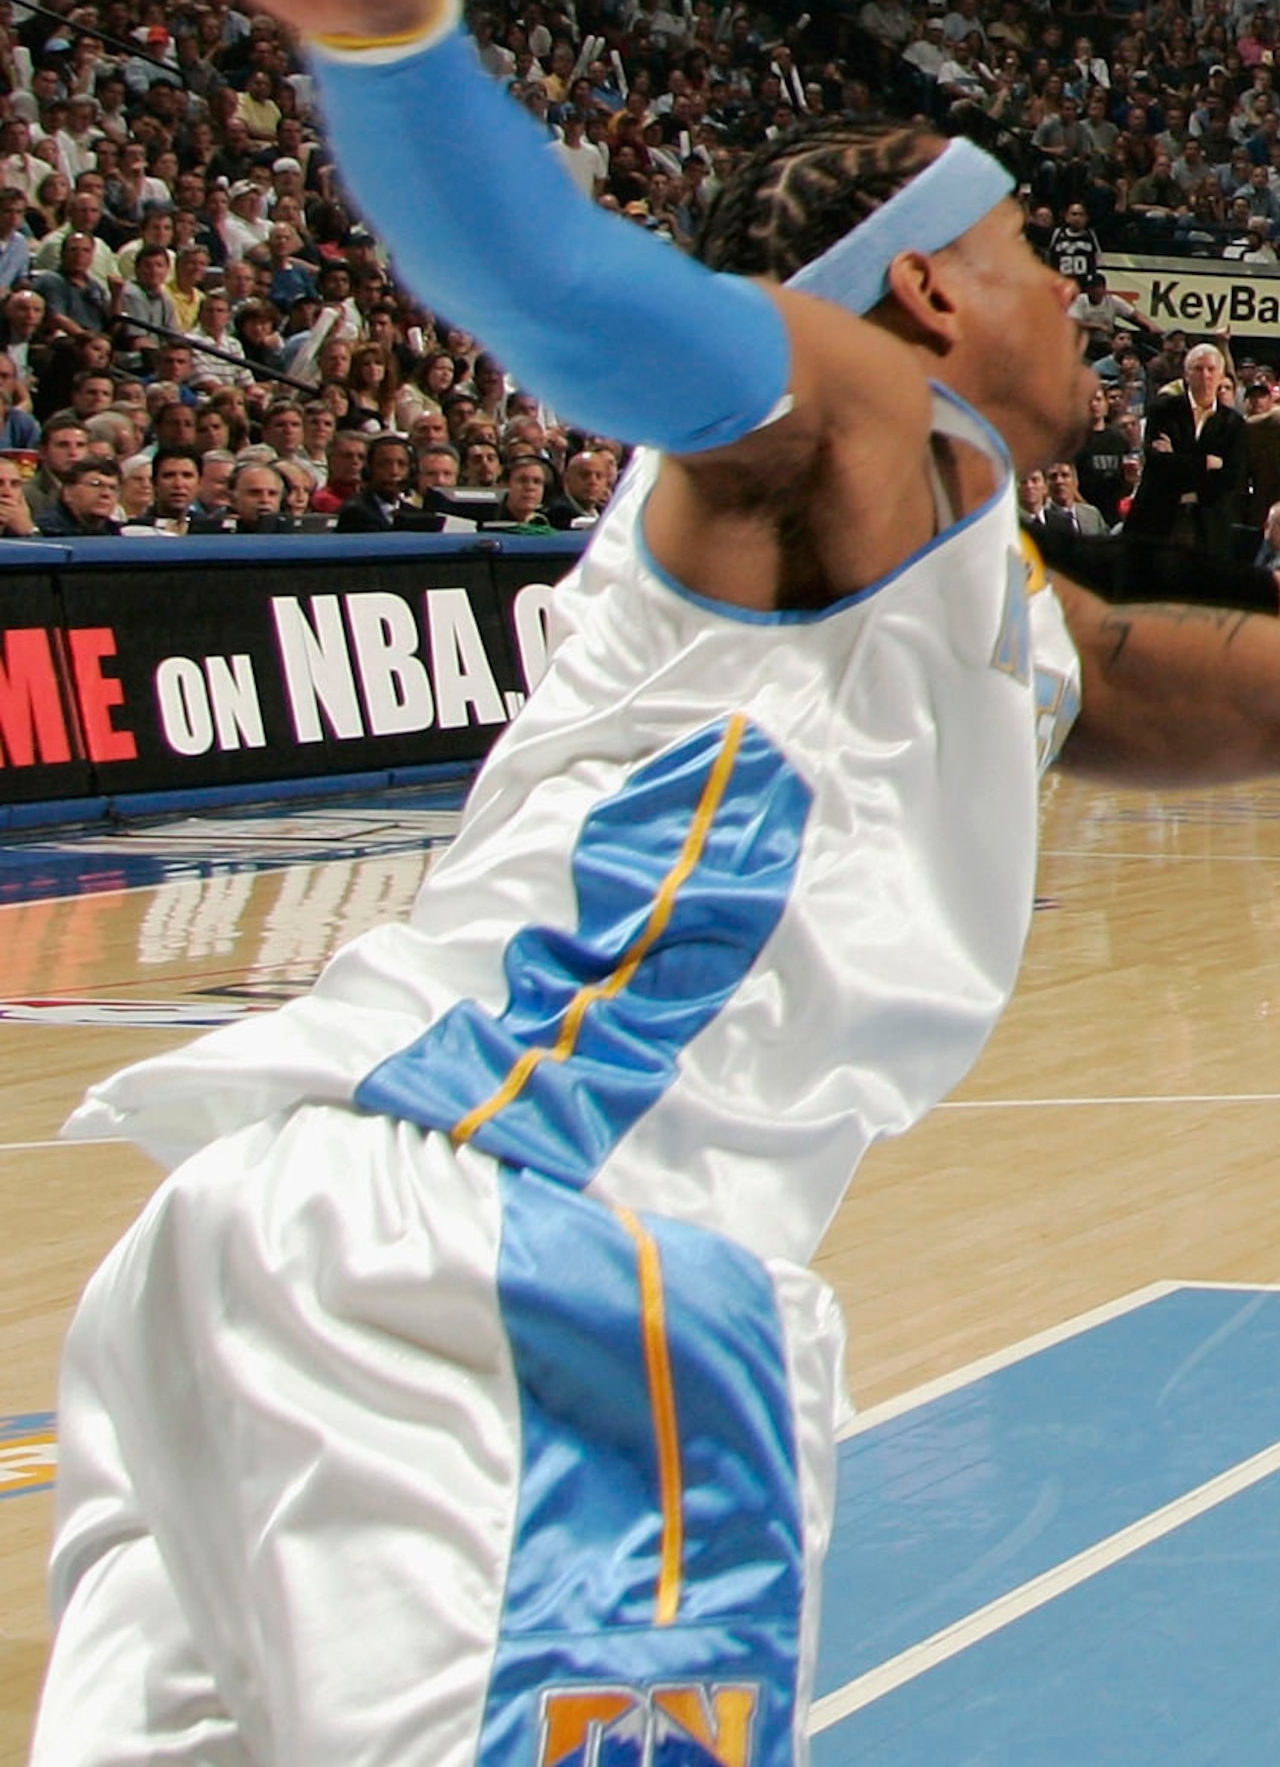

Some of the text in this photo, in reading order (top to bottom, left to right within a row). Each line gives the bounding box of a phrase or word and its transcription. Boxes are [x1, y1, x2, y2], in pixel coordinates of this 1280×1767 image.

[1060, 255, 1087, 274] 20
[0, 627, 137, 767] ME
[154, 654, 266, 756] ON
